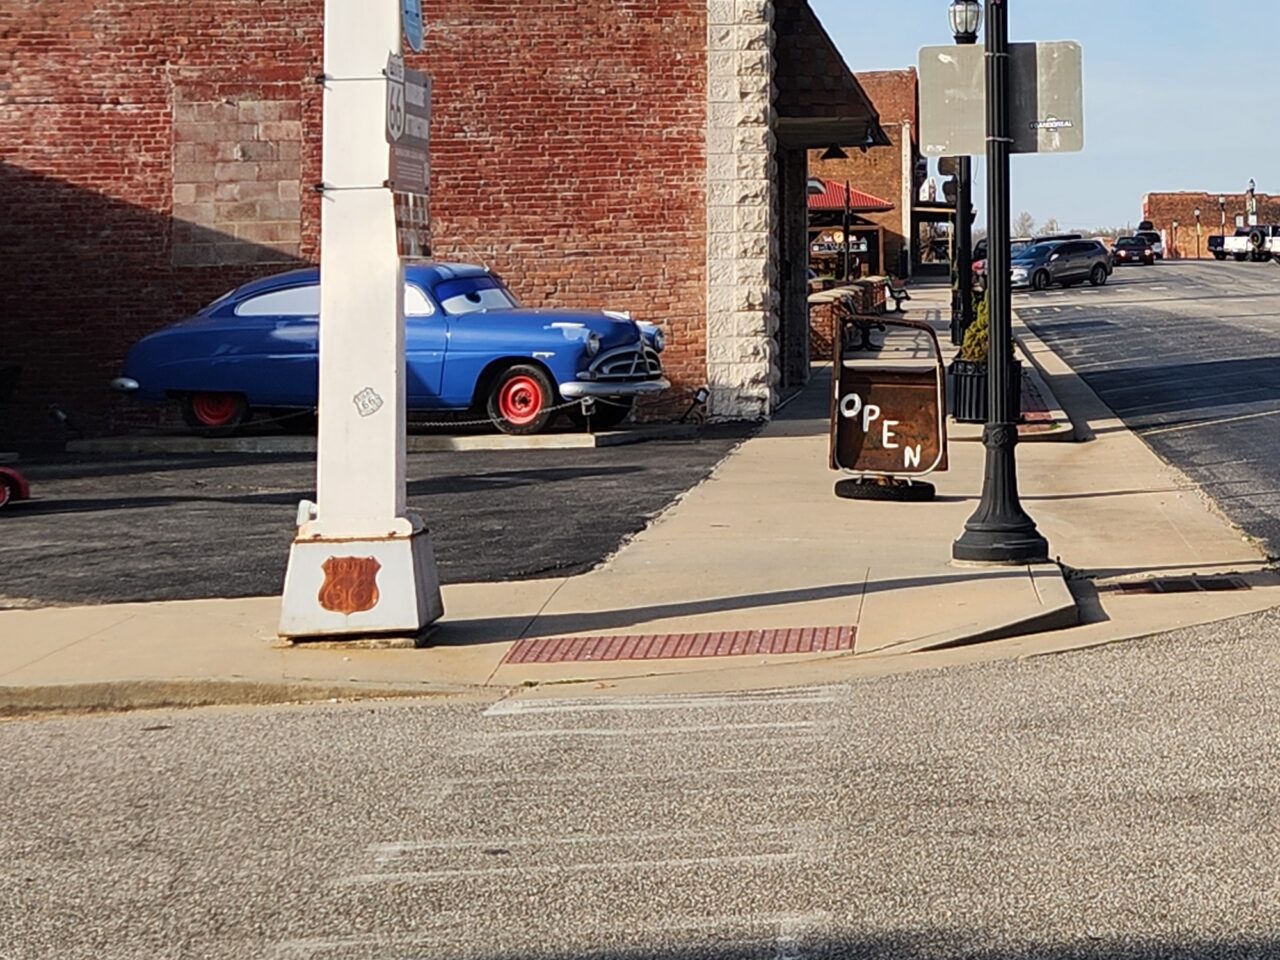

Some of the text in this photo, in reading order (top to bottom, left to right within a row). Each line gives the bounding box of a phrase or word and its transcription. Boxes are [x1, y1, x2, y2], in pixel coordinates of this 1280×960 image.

[389, 86, 402, 133] 66
[840, 393, 921, 468] OPEN
[323, 577, 374, 611] 66
